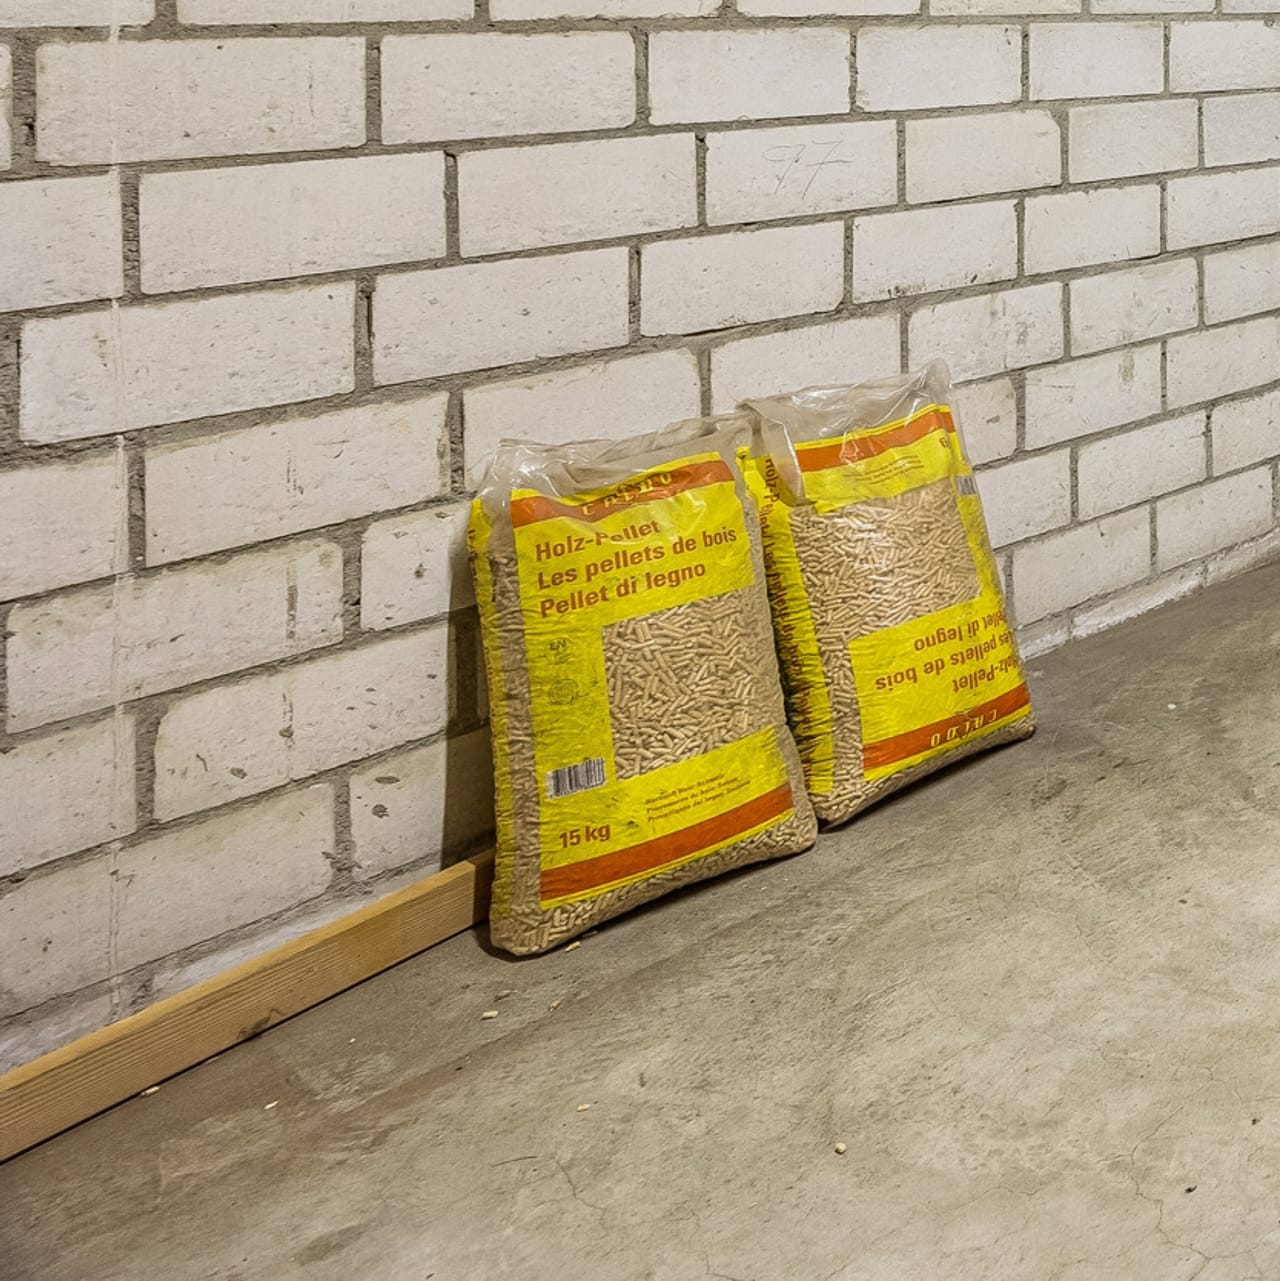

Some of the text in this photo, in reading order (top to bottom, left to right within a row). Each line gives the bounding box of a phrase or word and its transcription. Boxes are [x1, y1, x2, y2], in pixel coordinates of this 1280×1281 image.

[535, 520, 662, 562] Holz-Pellet
[538, 525, 737, 591] Les pellets de bois
[540, 562, 706, 618] Pellet di legno
[914, 623, 964, 652] legno
[967, 620, 980, 639] di
[950, 634, 997, 666] pellets
[875, 667, 918, 691] bois
[923, 658, 945, 676] de
[559, 824, 611, 849] 15 kg
